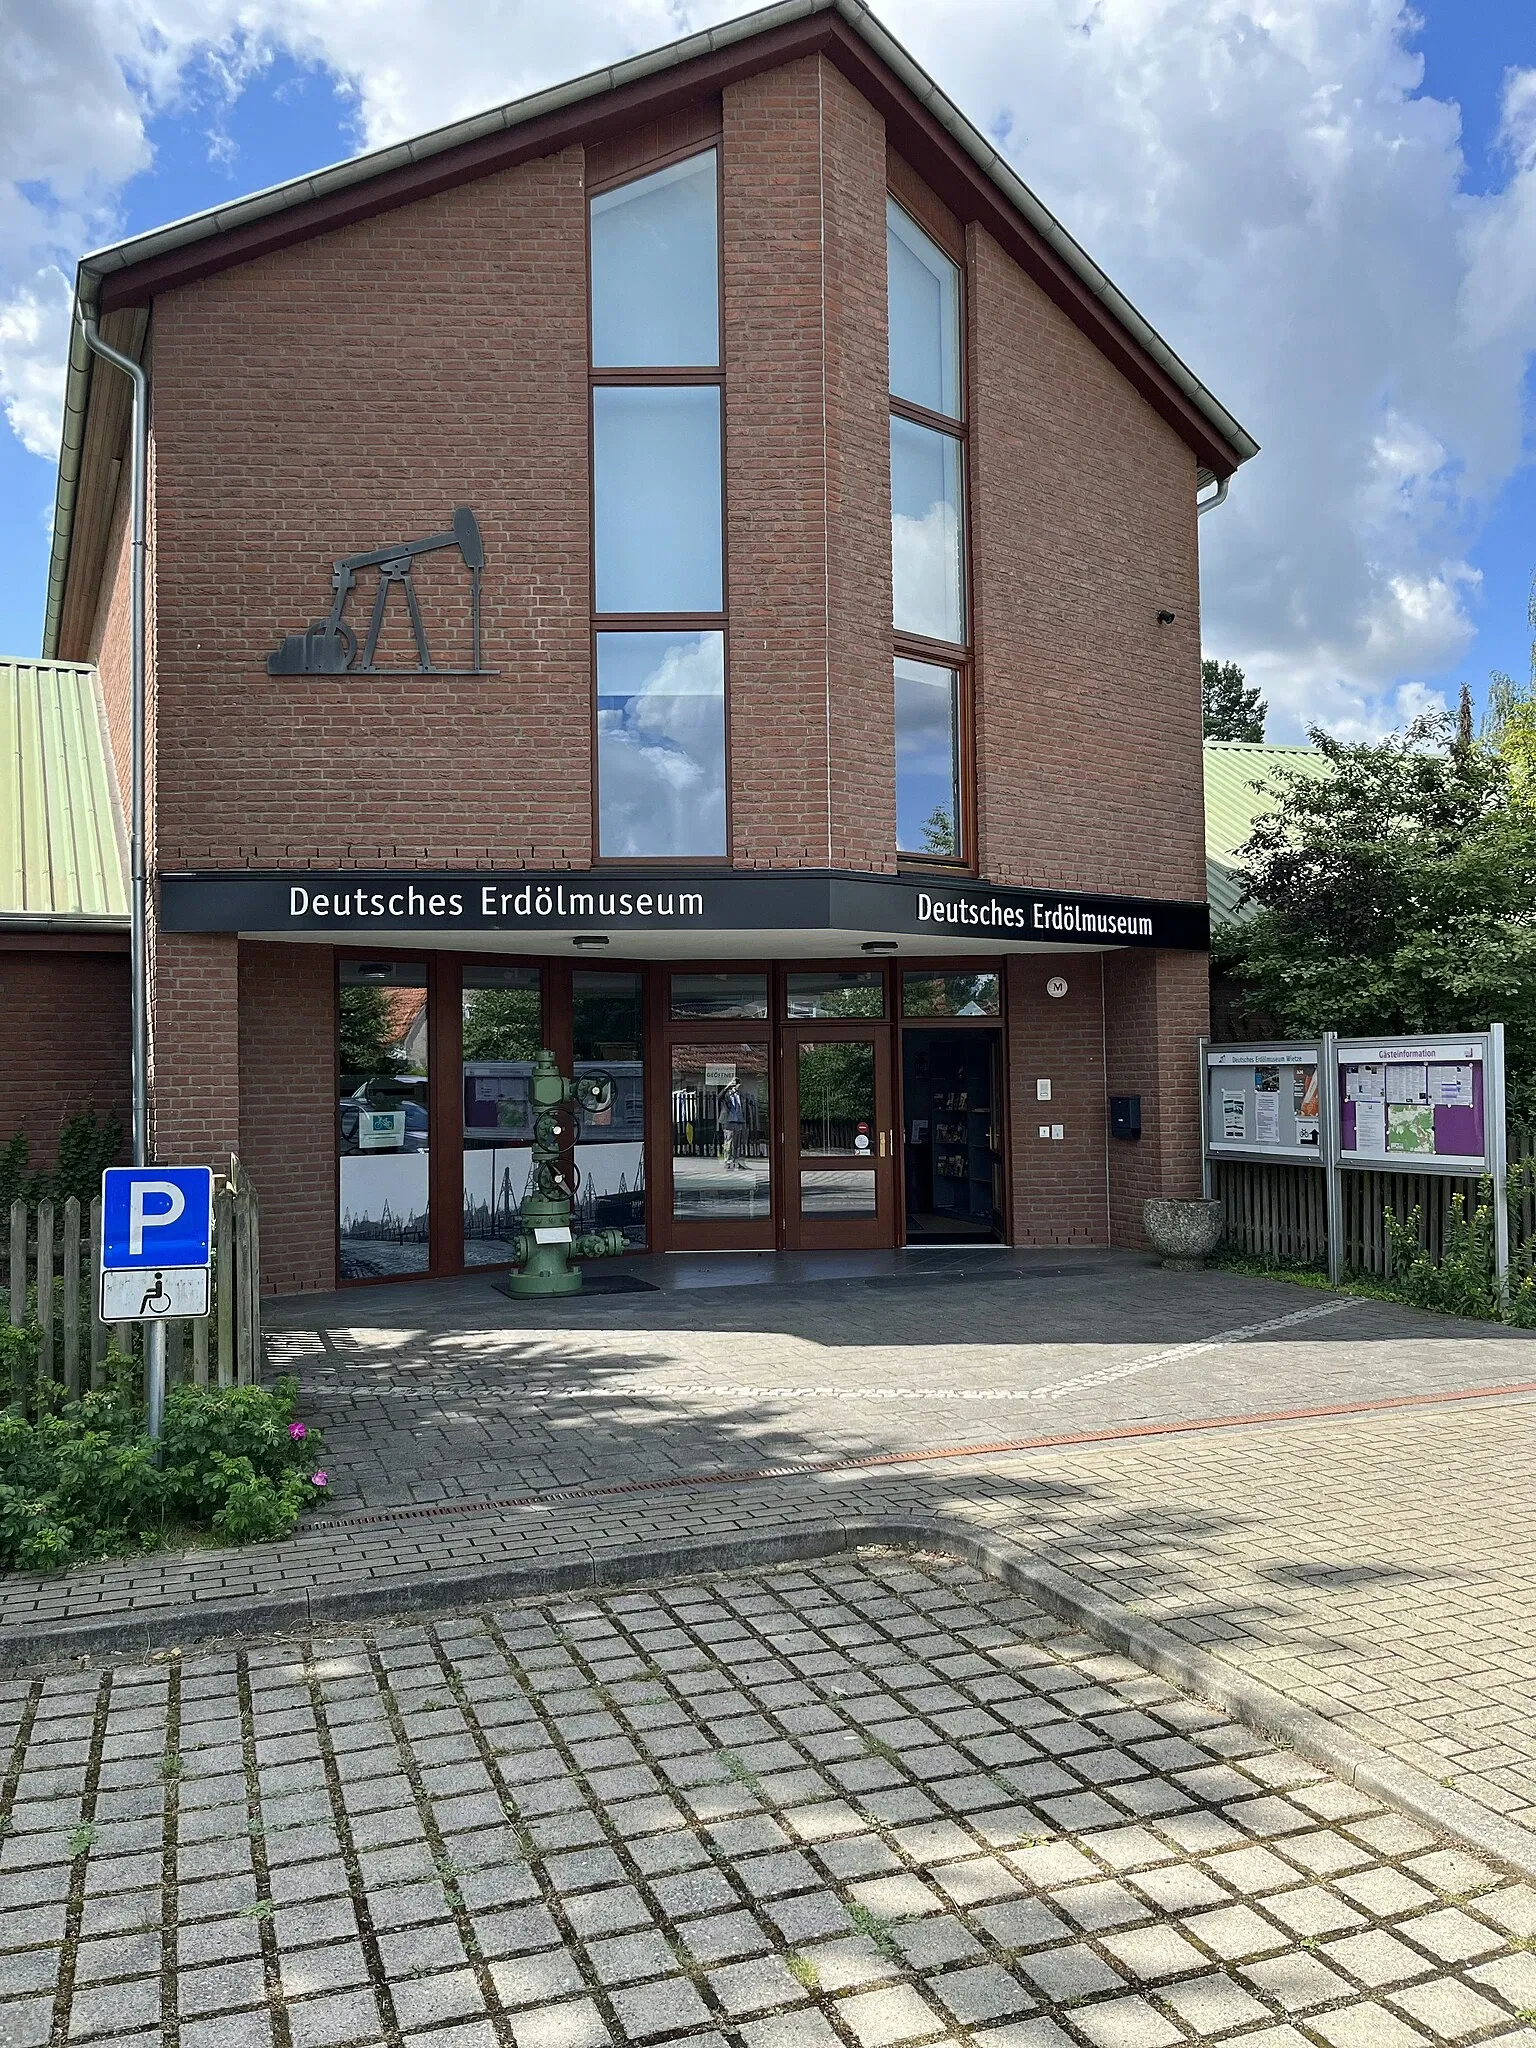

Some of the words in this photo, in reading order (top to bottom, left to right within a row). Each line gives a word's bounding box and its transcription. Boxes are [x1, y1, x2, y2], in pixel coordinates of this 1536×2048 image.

[290, 885, 463, 916] Deutsches
[481, 885, 704, 916] Erdölmuseum
[917, 893, 1024, 928] Deutsches
[1033, 903, 1153, 935] Erdölmuseum
[1053, 983, 1063, 992] M
[1378, 1048, 1436, 1059] Gästeinformation
[129, 1181, 186, 1255] P
